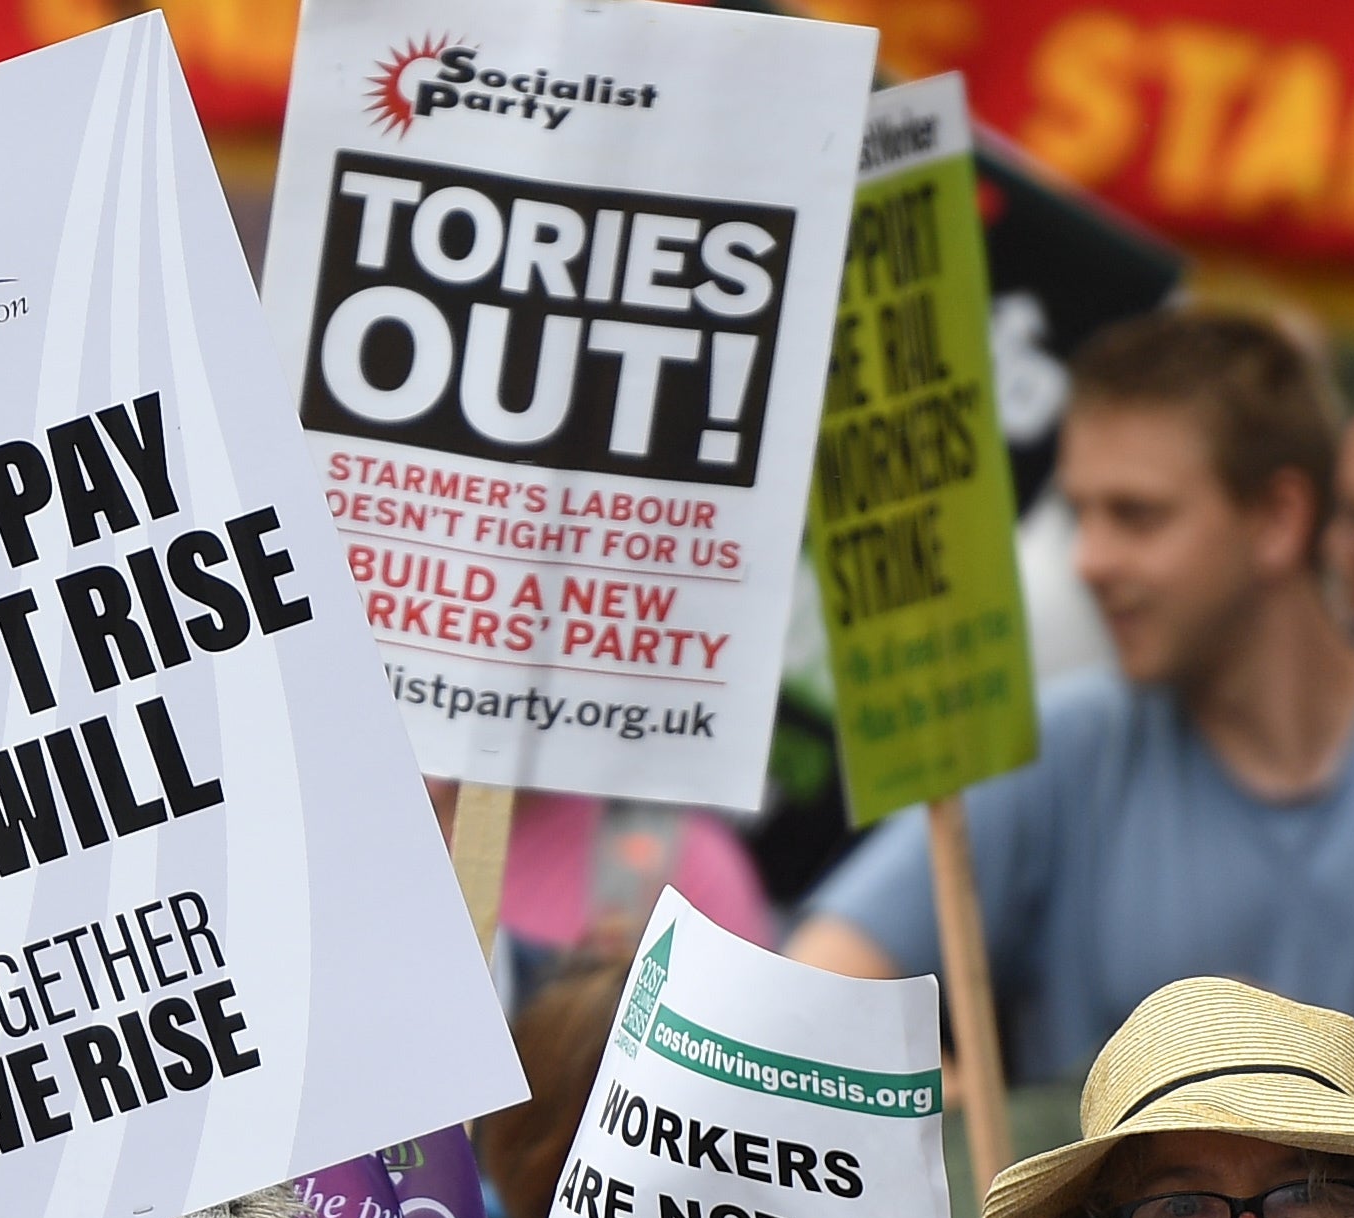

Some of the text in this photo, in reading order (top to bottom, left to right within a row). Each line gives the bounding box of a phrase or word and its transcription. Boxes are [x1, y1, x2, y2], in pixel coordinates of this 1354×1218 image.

[414, 79, 572, 130] Party
[437, 45, 659, 109] Socialist
[338, 170, 779, 318] TORIES
[320, 283, 761, 467] OUT!
[328, 452, 717, 531] STARMER'S LABOUR
[348, 543, 679, 624] BUILD A NEW
[475, 514, 593, 556] FIGHT
[602, 528, 678, 565] FOR
[690, 538, 742, 572] US
[55, 505, 315, 694] RISE
[562, 619, 732, 670] PARTY
[62, 978, 262, 1126] RISE
[653, 1022, 935, 1113] costoflivingcrisis.org
[599, 1078, 864, 1199] WORKERS
